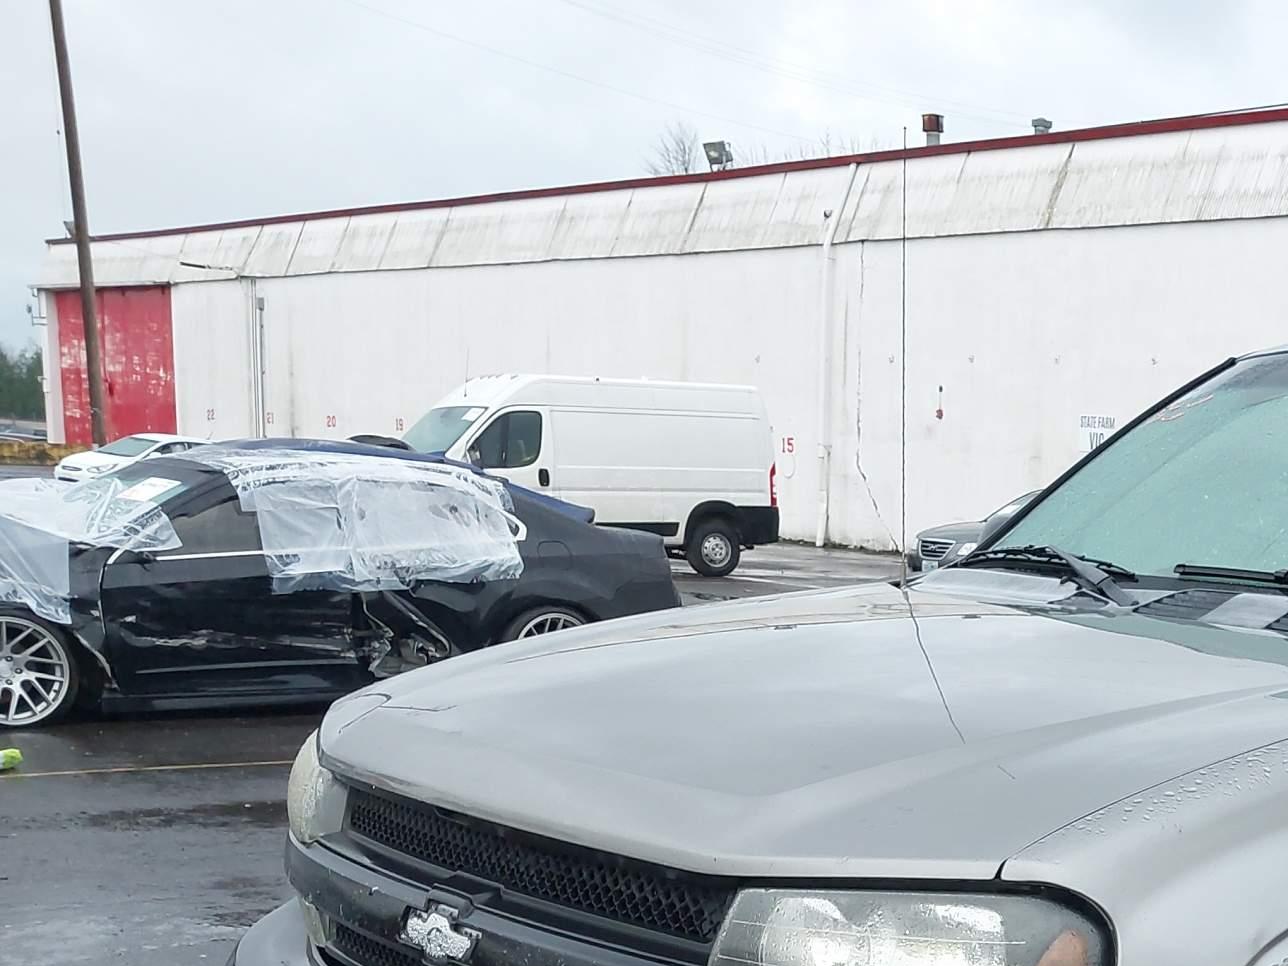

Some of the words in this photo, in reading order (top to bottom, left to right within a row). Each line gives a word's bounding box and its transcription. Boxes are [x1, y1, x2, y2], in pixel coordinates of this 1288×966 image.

[326, 415, 337, 428] 20
[1080, 415, 1097, 429] STATE
[1098, 416, 1116, 430] FARM
[782, 437, 794, 453] 15
